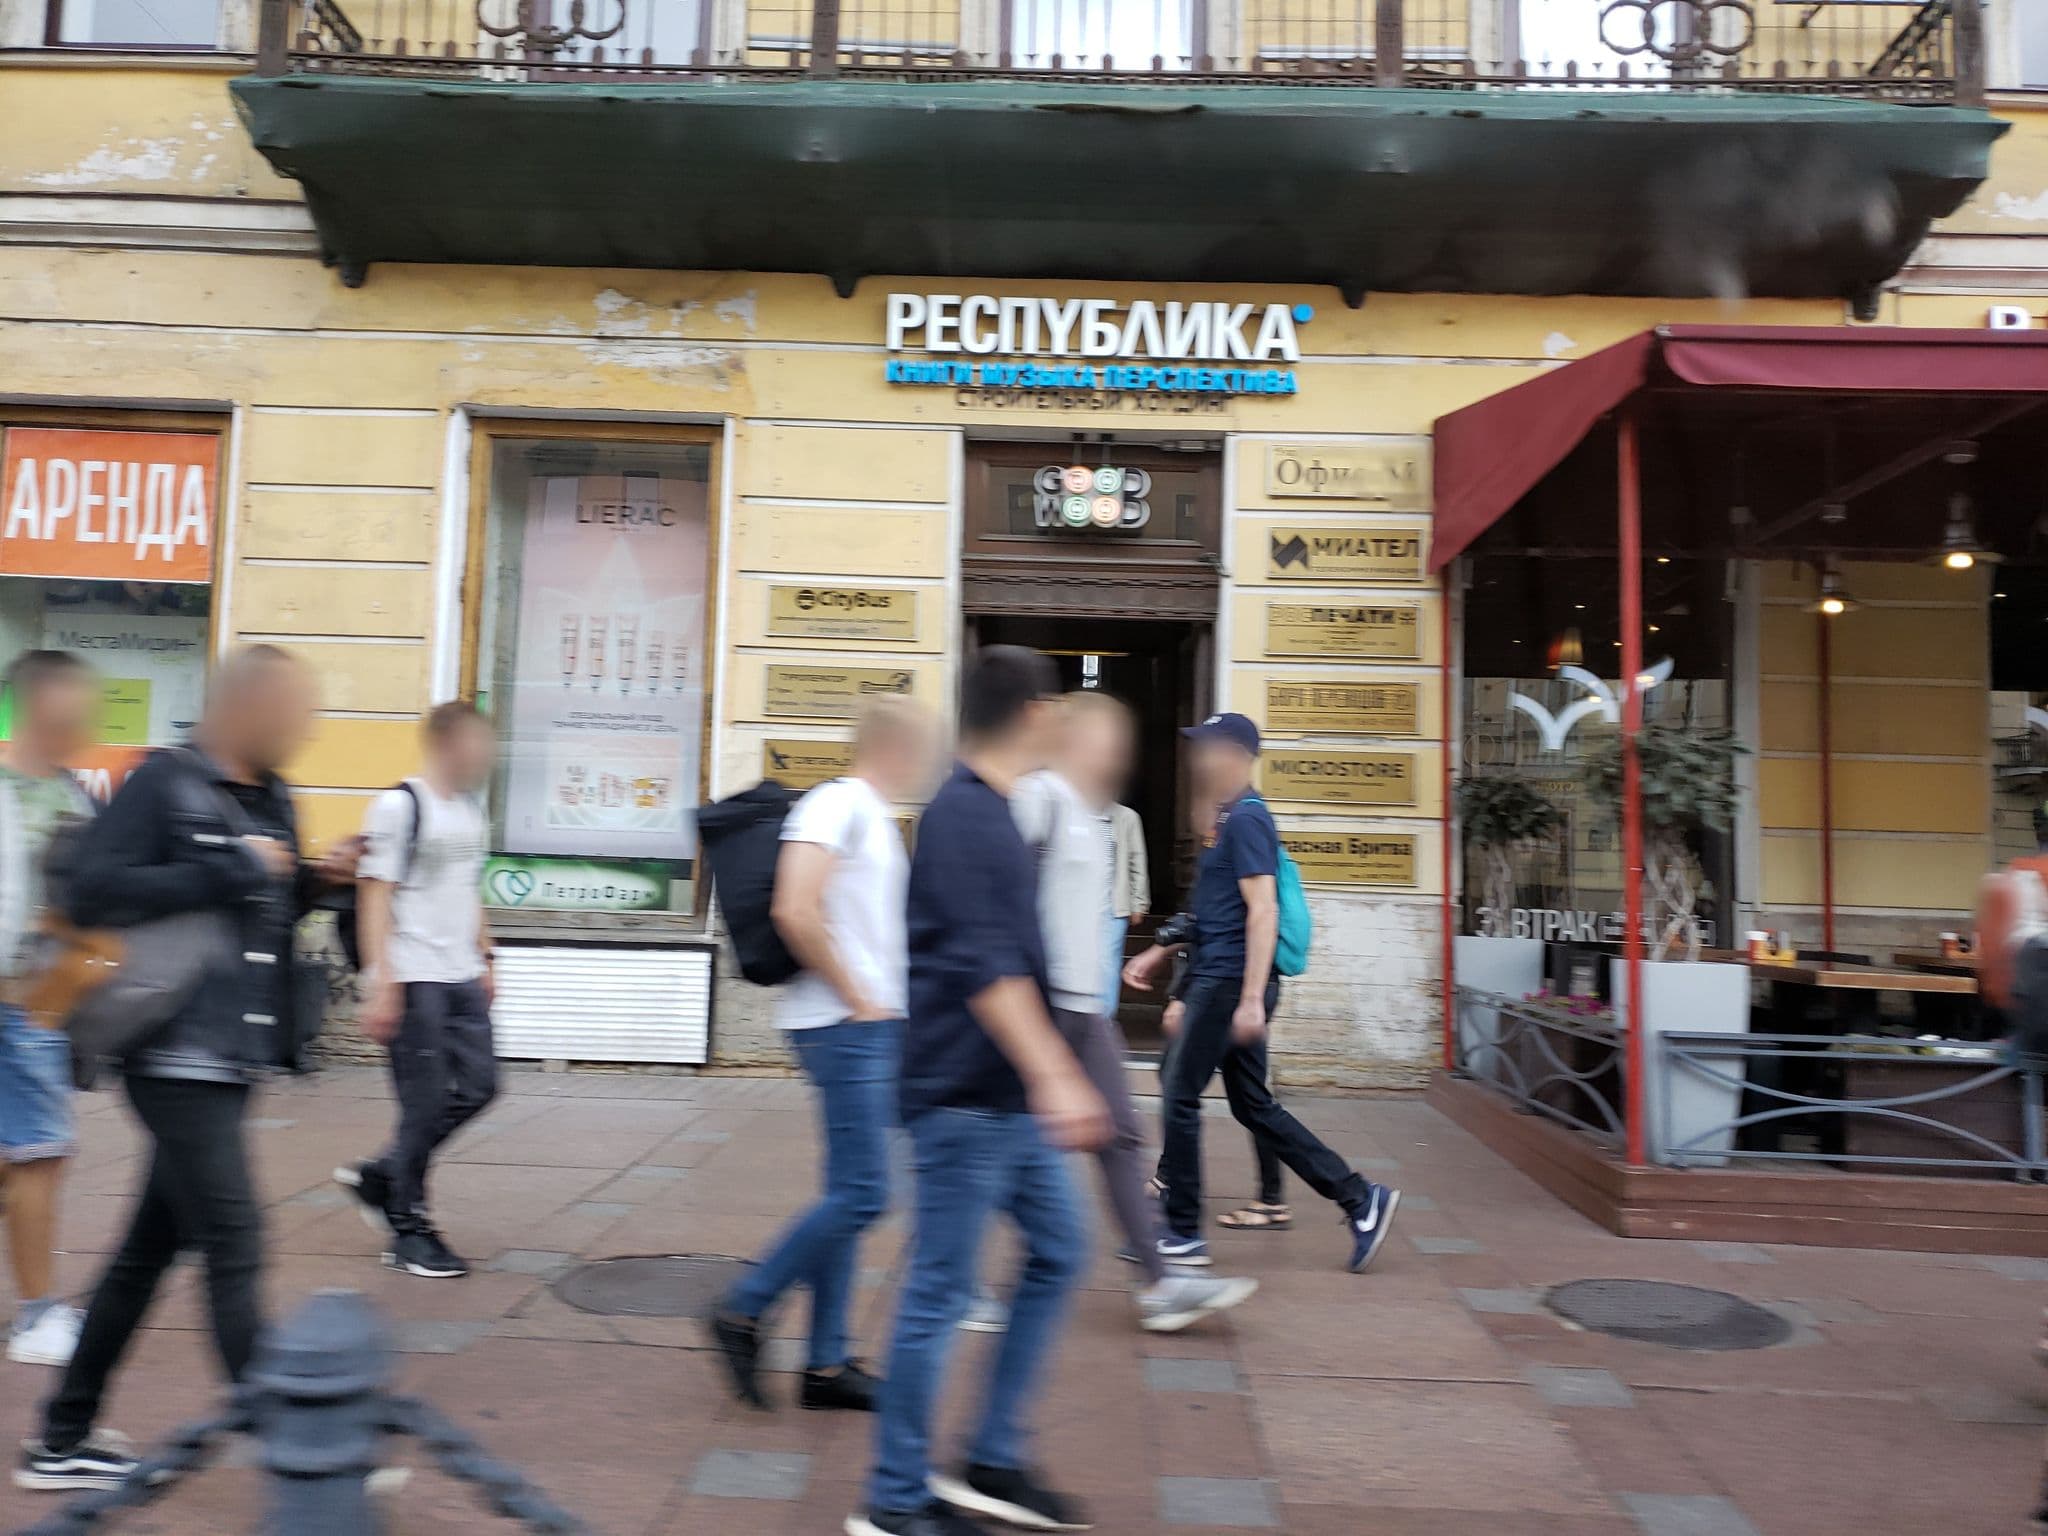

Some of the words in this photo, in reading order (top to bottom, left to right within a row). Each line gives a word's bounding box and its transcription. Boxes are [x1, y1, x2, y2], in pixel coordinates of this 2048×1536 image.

[886, 293, 1300, 363] РЕСПУБЛИКА
[981, 362, 1098, 388] МУЗЫКА
[1104, 365, 1297, 394] ПЕРСПЕКТИВА
[4, 457, 209, 562] АРЕНДА
[576, 504, 676, 527] LIERAC
[819, 590, 892, 611] CityBus
[1270, 759, 1405, 779] MICROSTORE
